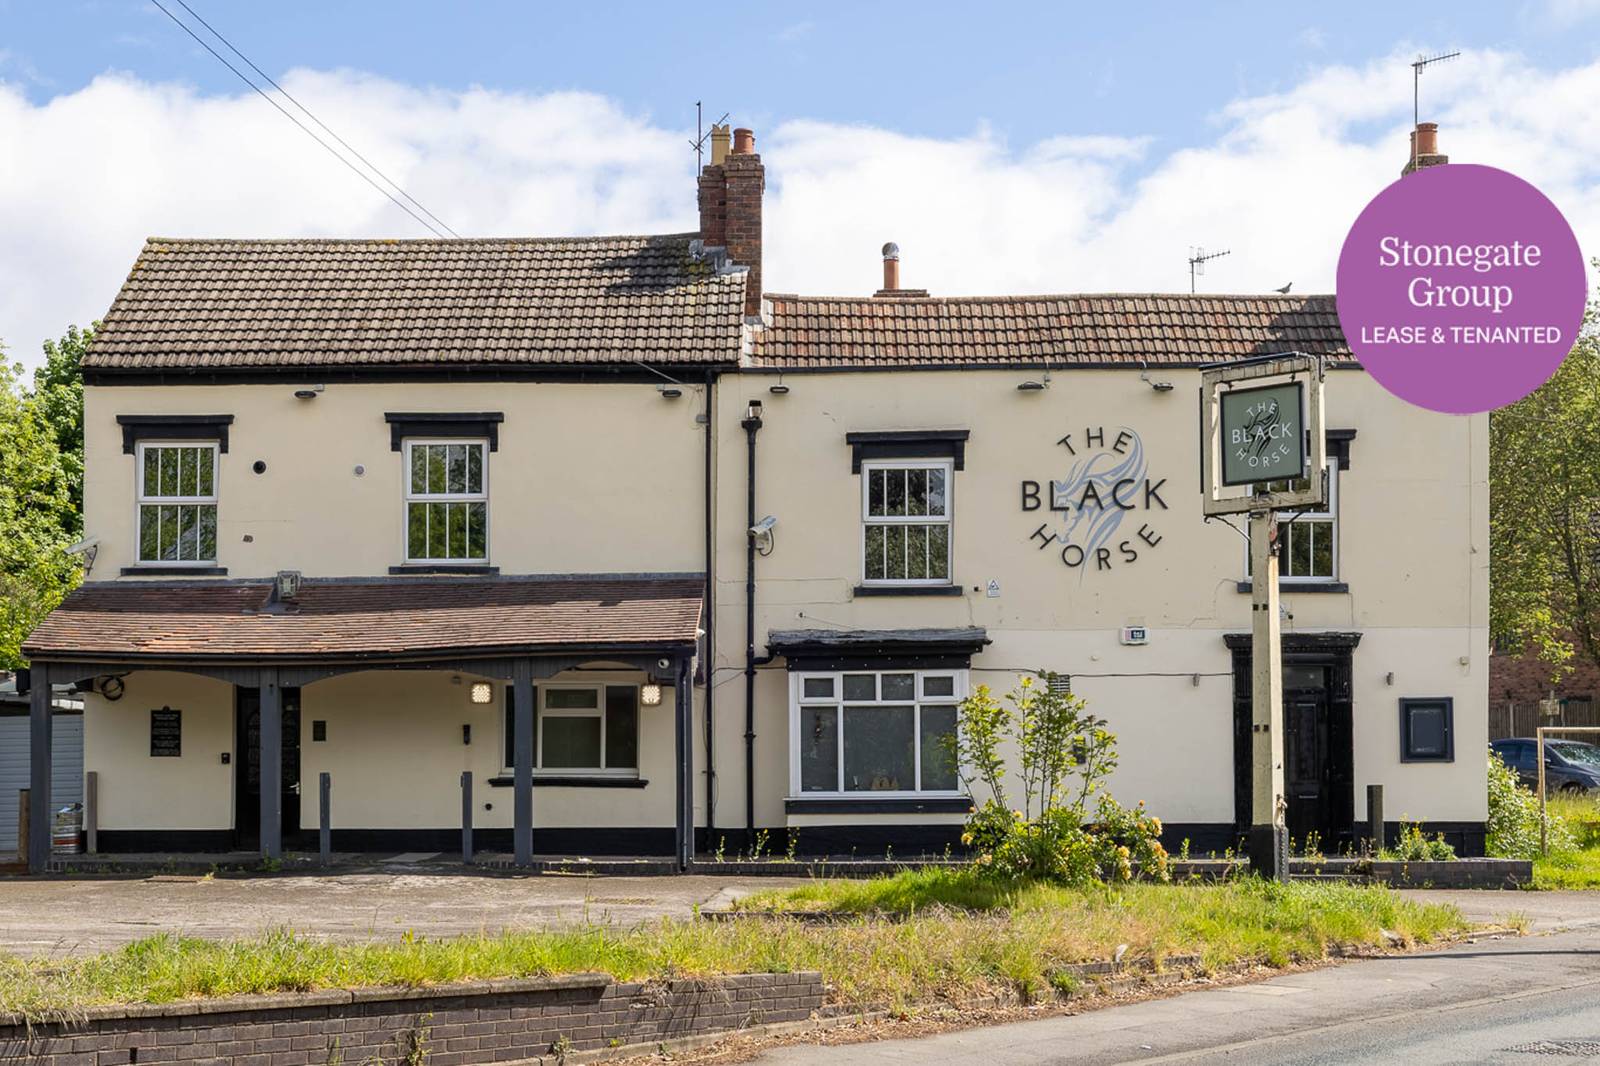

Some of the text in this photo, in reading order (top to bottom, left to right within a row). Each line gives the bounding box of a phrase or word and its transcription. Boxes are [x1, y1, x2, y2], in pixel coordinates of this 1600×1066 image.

[1246, 402, 1278, 417] THE
[1056, 426, 1133, 456] THE
[1232, 422, 1293, 444] BLACK
[1235, 444, 1291, 468] HORSE
[1021, 478, 1169, 512] BLACK
[1029, 523, 1163, 571] HORSE
